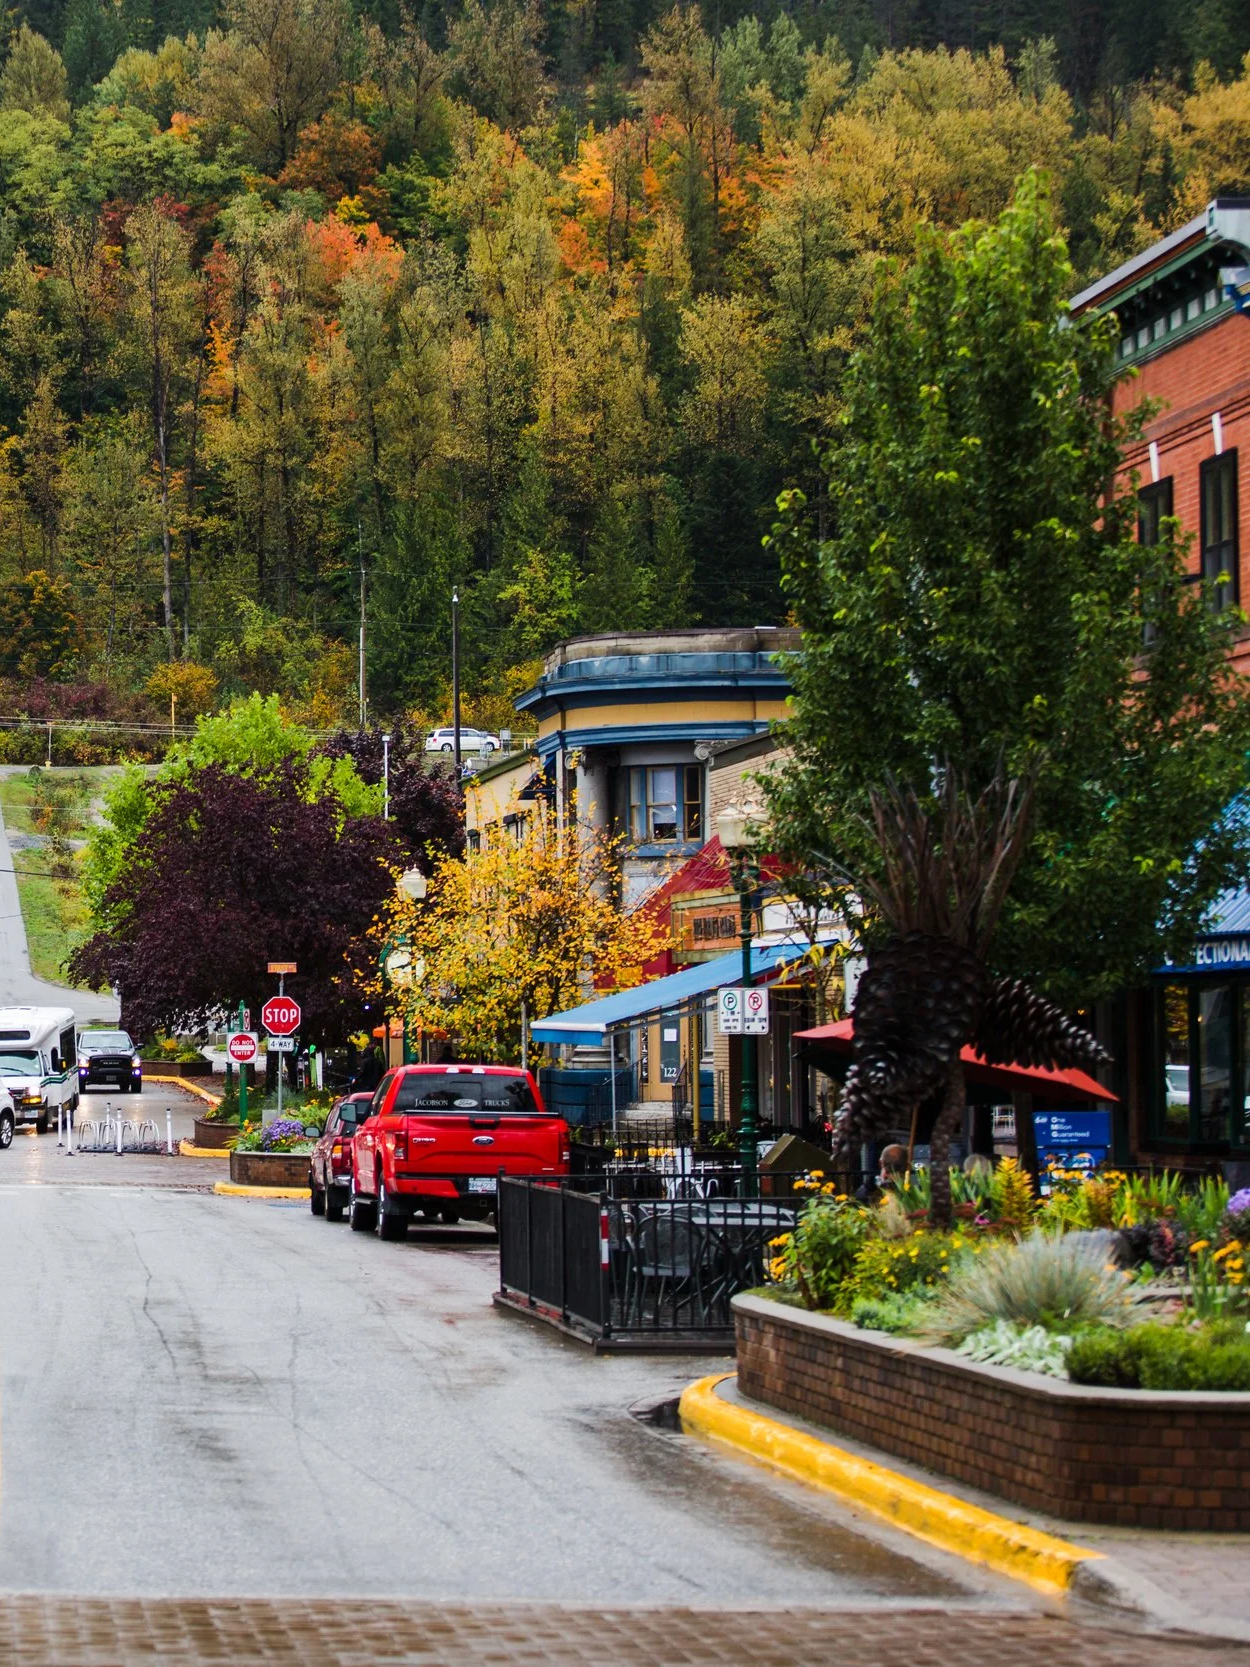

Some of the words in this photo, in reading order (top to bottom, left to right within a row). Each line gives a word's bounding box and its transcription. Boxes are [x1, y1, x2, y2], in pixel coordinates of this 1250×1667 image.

[265, 1008, 298, 1023] STOP
[270, 1040, 291, 1048] 4-WAY
[664, 1067, 677, 1077] 122
[415, 1098, 449, 1107] JACOBSON
[484, 1098, 510, 1107] TRUCKS
